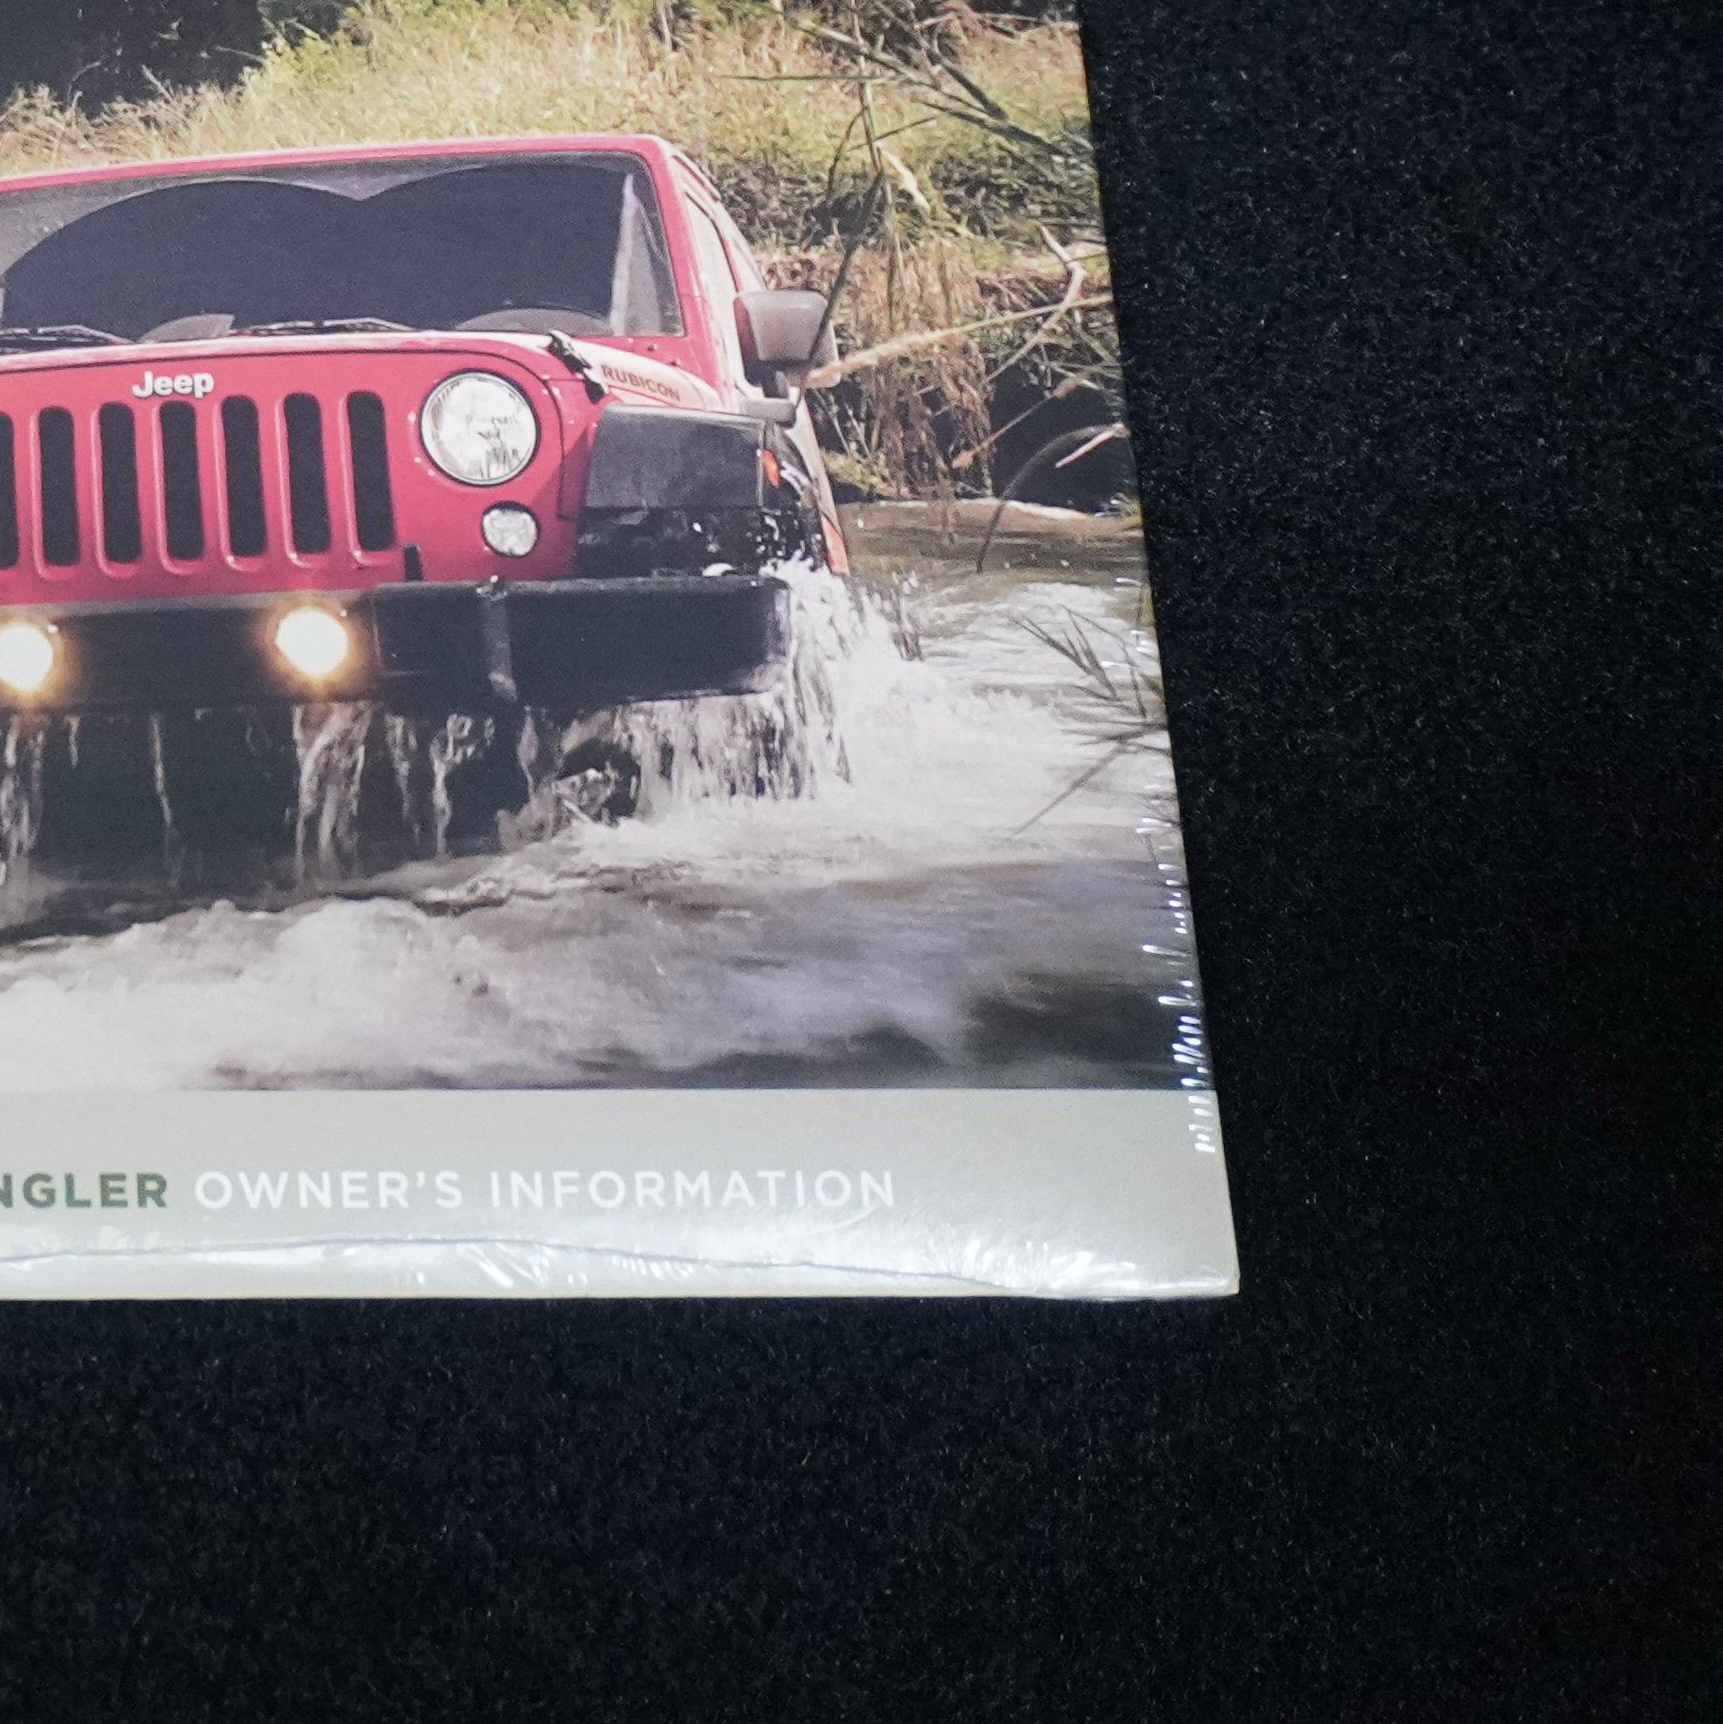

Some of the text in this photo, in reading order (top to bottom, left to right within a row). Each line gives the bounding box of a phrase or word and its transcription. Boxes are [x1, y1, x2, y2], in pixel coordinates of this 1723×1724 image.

[132, 371, 214, 398] Jeep
[601, 364, 681, 402] RUBICON
[194, 1170, 463, 1209] OWNER'S
[491, 1168, 895, 1208] INFORMATION
